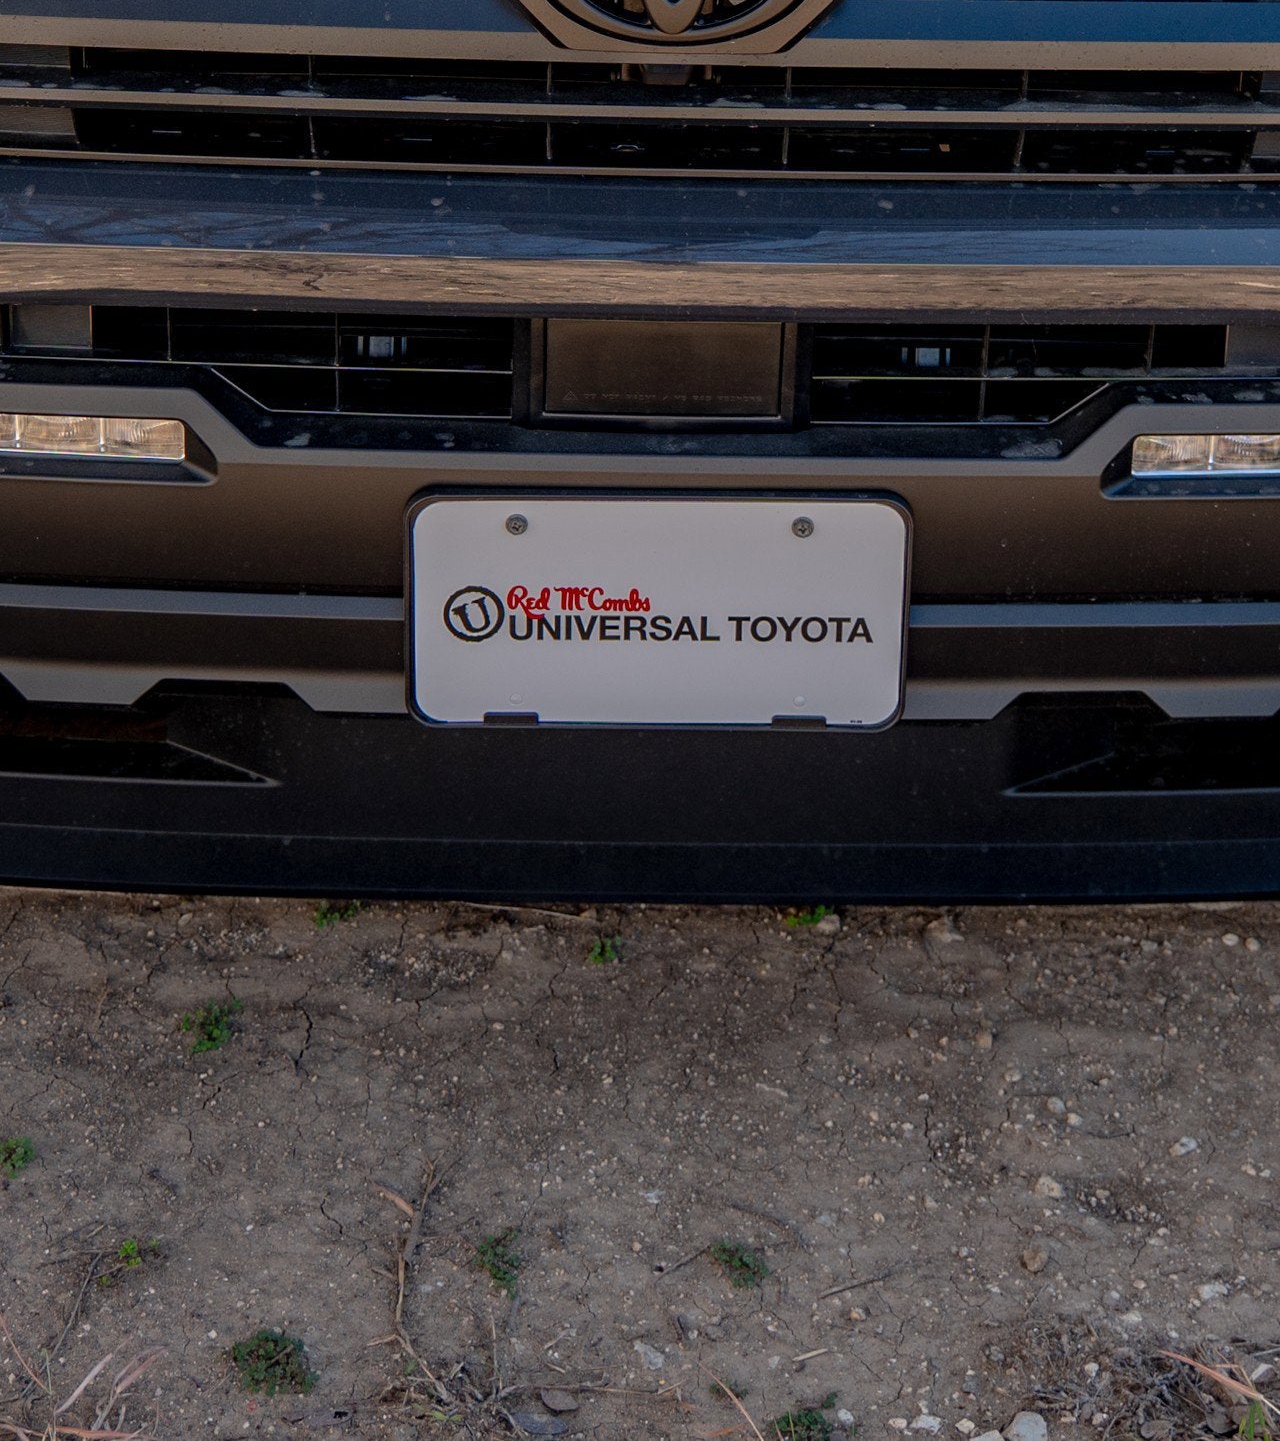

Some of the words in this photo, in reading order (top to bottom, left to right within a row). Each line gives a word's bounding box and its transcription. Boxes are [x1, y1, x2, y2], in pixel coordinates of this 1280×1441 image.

[507, 585, 551, 620] Red
[554, 586, 651, 612] McCombs
[509, 614, 720, 642] UNIVERSAL
[727, 615, 874, 643] TOYOTA
